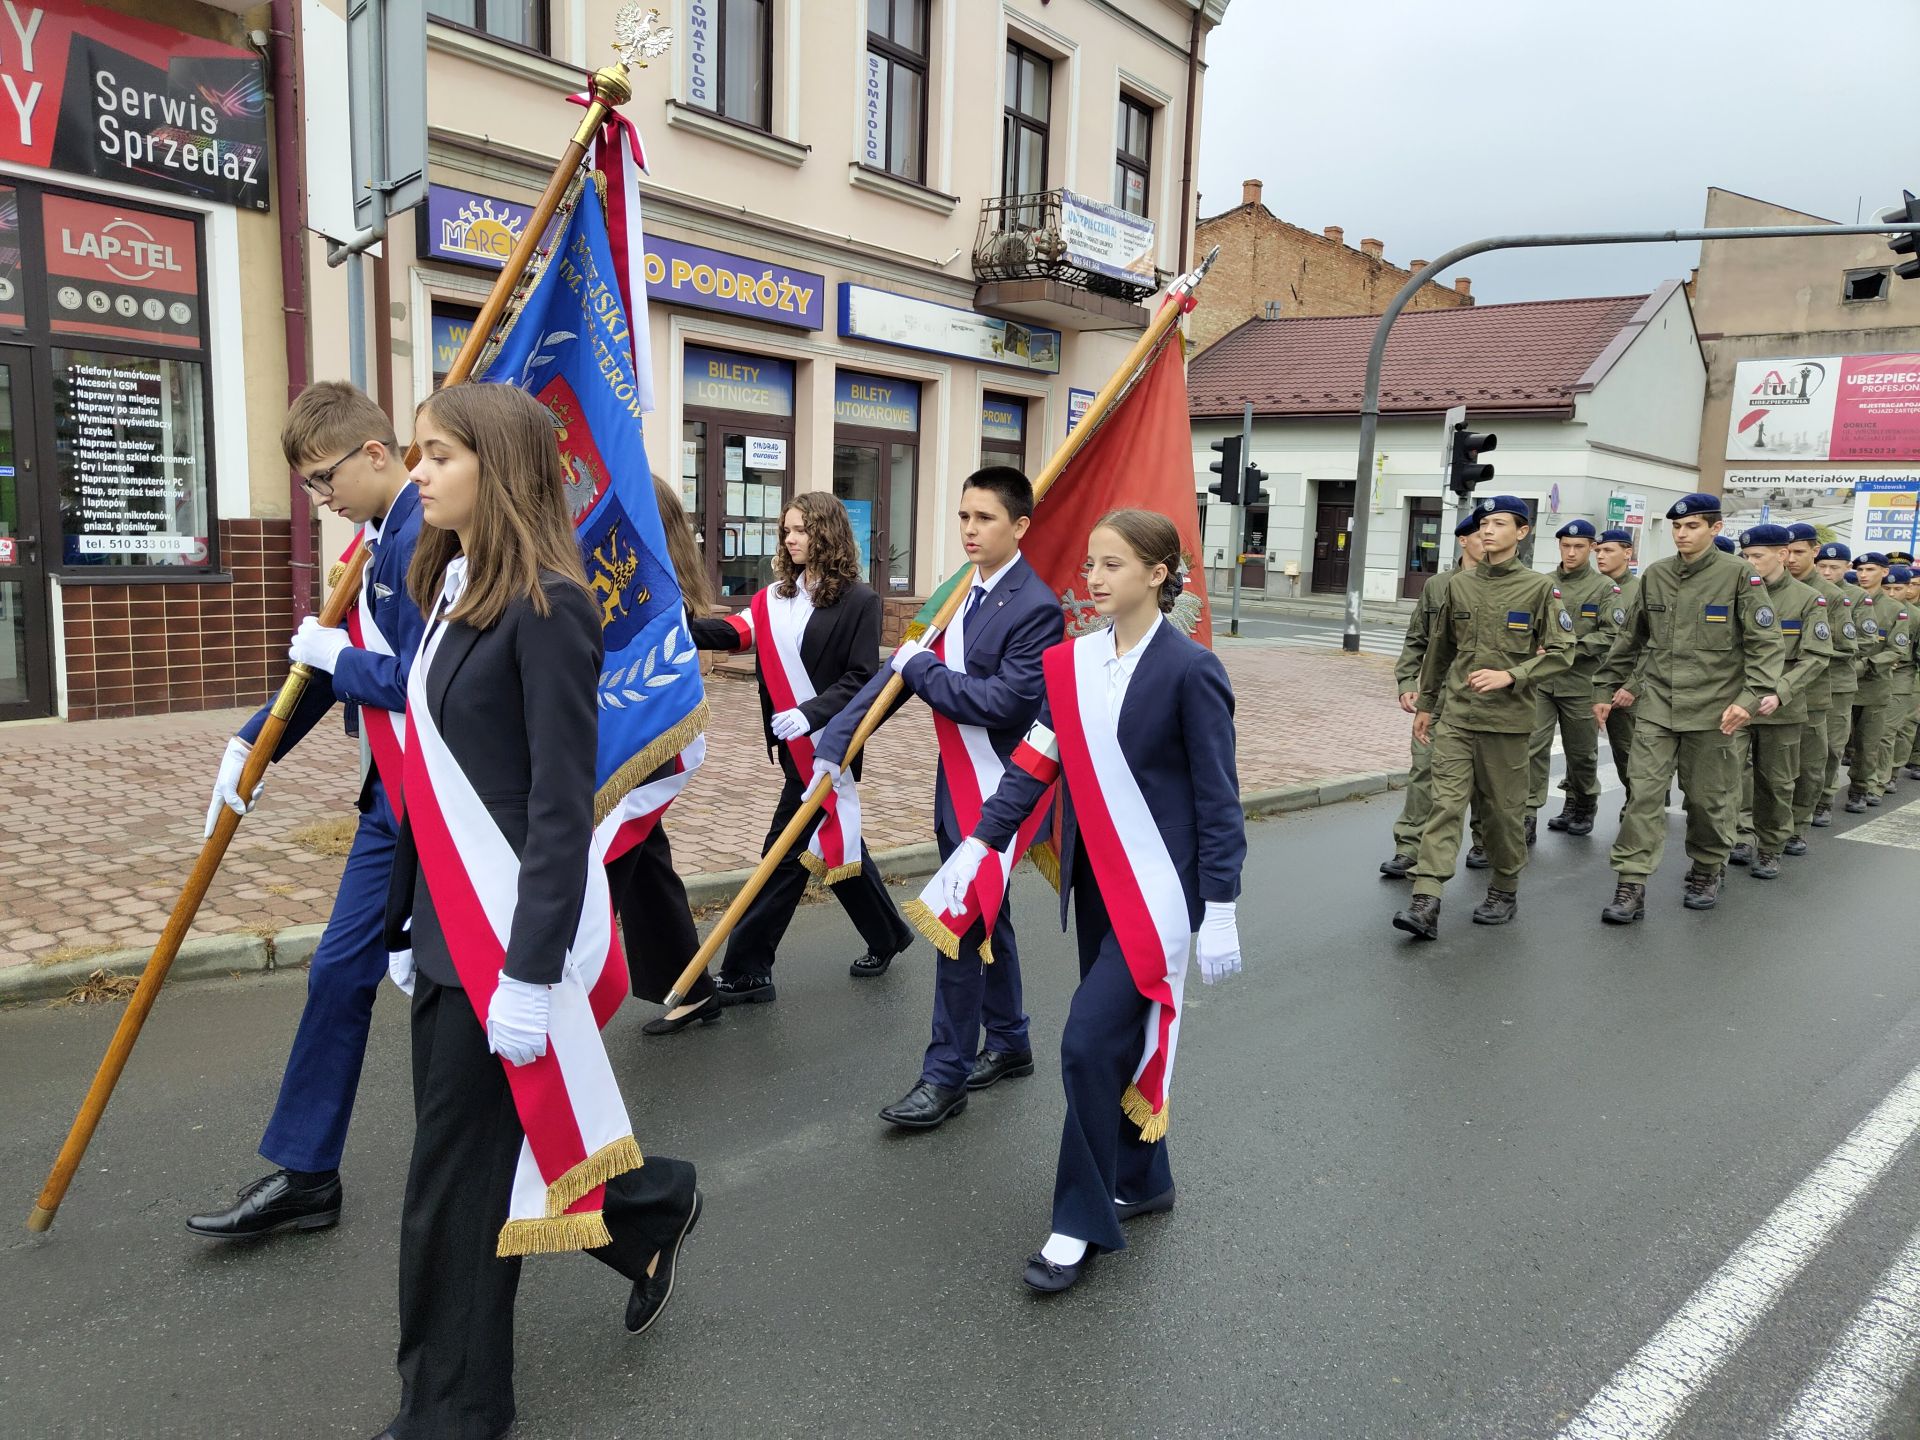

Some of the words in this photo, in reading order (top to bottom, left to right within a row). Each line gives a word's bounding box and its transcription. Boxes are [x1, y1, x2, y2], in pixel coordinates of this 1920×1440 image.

[692, 0, 707, 100] OMATOLOG
[96, 71, 218, 135] Serwis
[867, 57, 880, 160] STOMATOLOG
[100, 115, 258, 184] Sprzedaż
[61, 228, 182, 272] LAP-TEL
[671, 259, 813, 314] PODRÓŻY
[75, 365, 113, 378] Telefony
[114, 368, 161, 382] komórkowe
[709, 360, 760, 384] BILETY
[76, 377, 117, 390] Akcesoria
[119, 381, 137, 391] GSM
[1862, 384, 1920, 393] PROFESJON
[77, 390, 114, 402] Naprawy
[116, 394, 127, 402] na
[128, 395, 160, 405] miejscu
[698, 382, 769, 406] LOTNICZE
[851, 384, 892, 403] BILETY
[77, 402, 115, 415] Naprawy
[117, 407, 127, 415] po
[129, 407, 158, 416] zalaniu
[834, 401, 910, 424] UTOKAROWE
[78, 413, 118, 425] Wymiana
[119, 417, 172, 431] wyświetlaczy
[983, 410, 1012, 425] PROMY
[78, 425, 82, 435] i
[83, 426, 113, 437] szybek
[79, 438, 117, 449] Naprawa
[119, 440, 155, 451] tabletów
[80, 450, 124, 461] Naklejanie
[126, 453, 150, 463] szkieł
[151, 454, 196, 466] ochronnych
[81, 462, 96, 473] Gry
[97, 462, 101, 472] i
[102, 463, 135, 473] konsole
[81, 474, 118, 485] Naprawa
[120, 475, 171, 487] komputerów
[172, 478, 184, 486] PC
[1730, 474, 1781, 483] Centrum
[1785, 474, 1855, 483] Materiałów
[82, 486, 106, 497] Skup,
[107, 487, 144, 498] sprzedaż
[145, 487, 184, 498] telefonów
[82, 497, 86, 507] i
[87, 498, 126, 509] laptopów
[83, 509, 122, 520] Wymiana
[124, 511, 173, 521] mikrofonów,
[84, 522, 114, 532] gniazd,
[116, 522, 157, 532] głośników
[86, 540, 106, 549] tel.
[110, 540, 131, 549] 510
[135, 540, 156, 549] 333
[160, 540, 180, 549] 018
